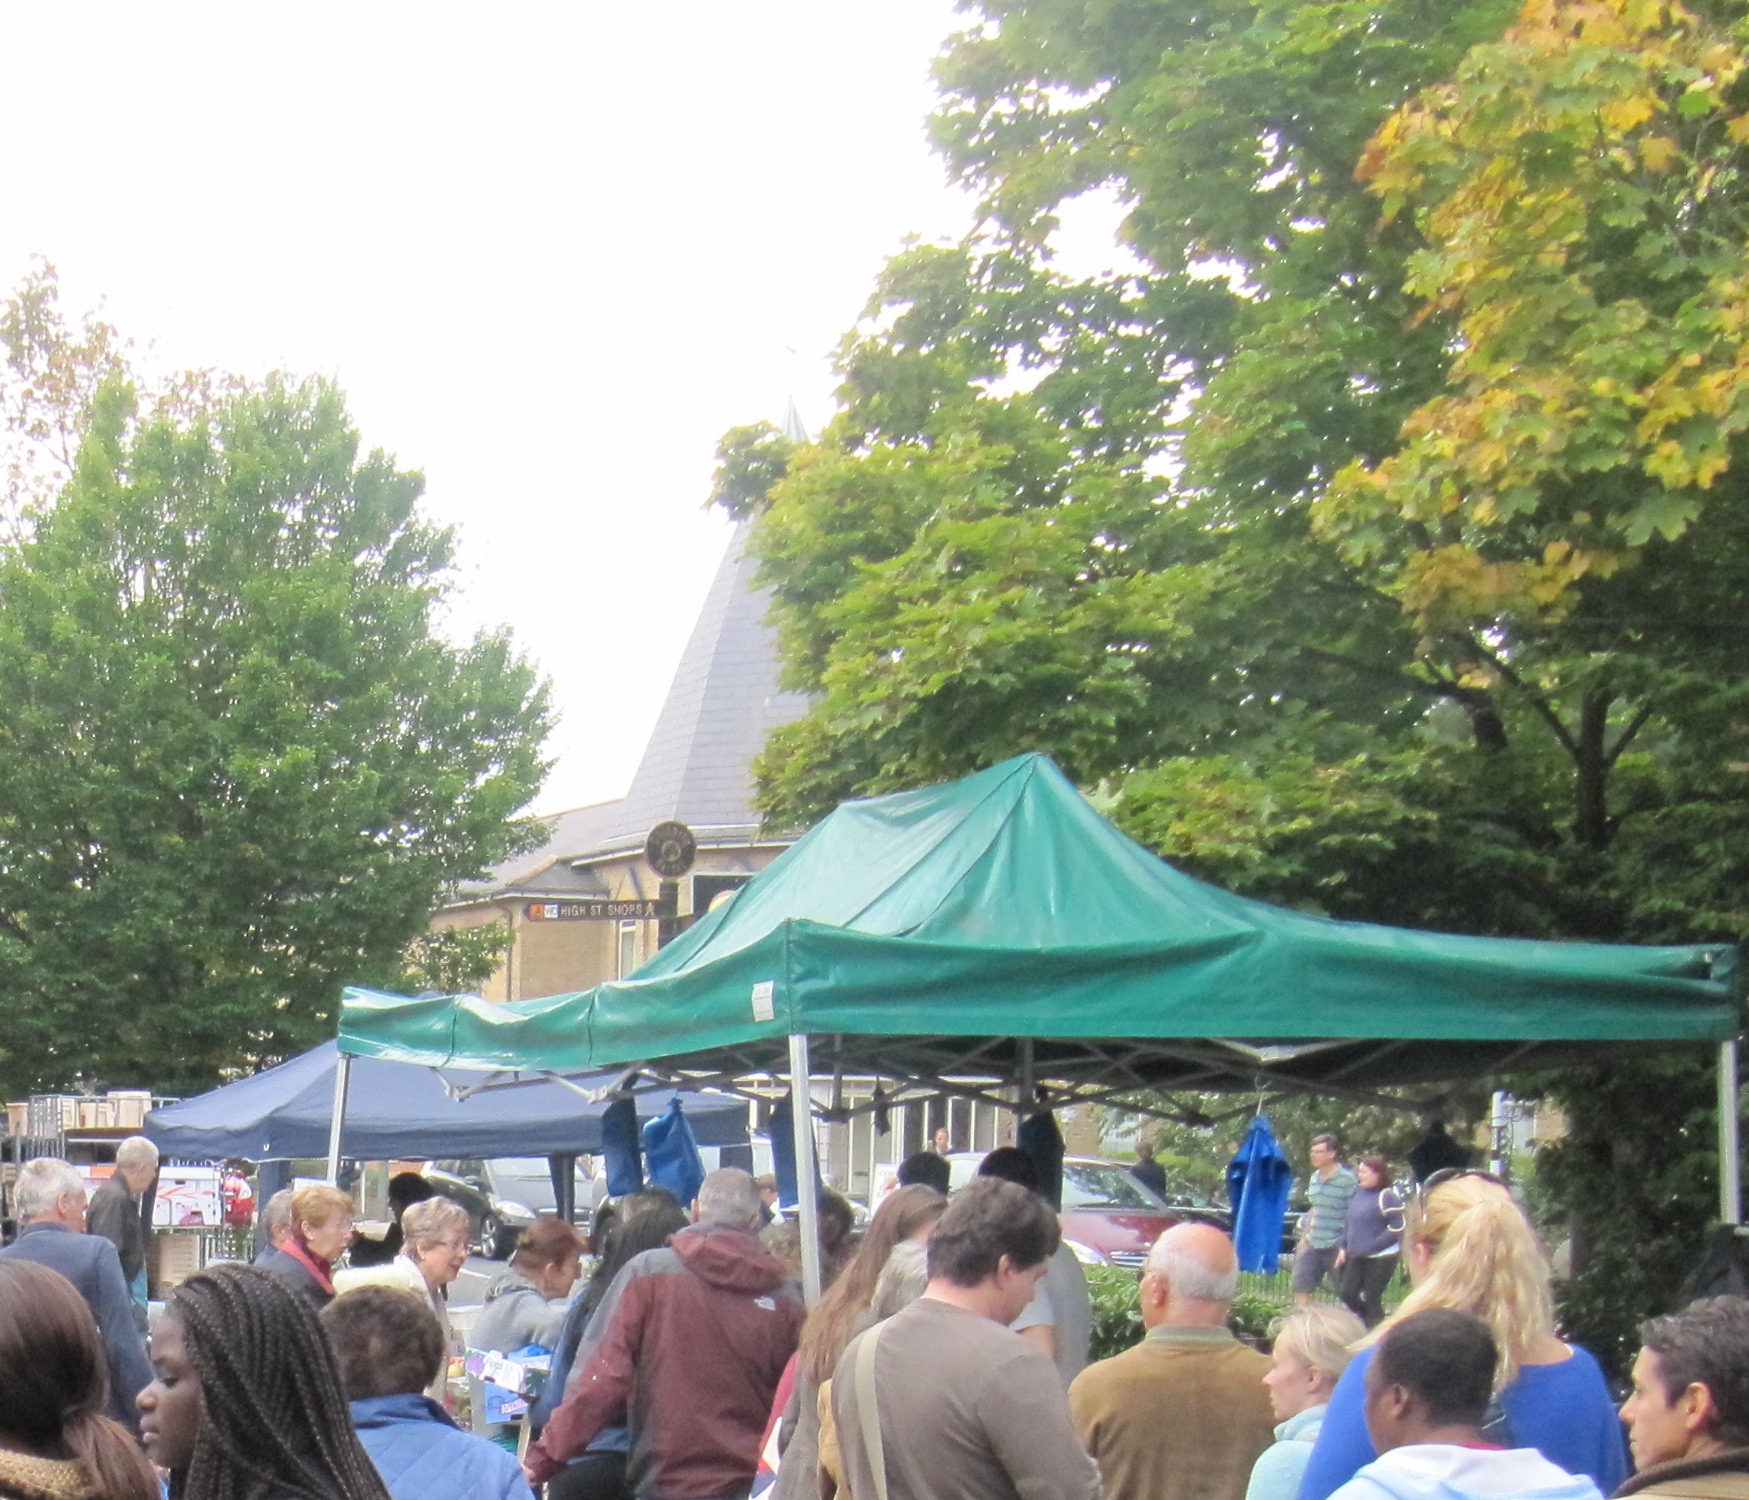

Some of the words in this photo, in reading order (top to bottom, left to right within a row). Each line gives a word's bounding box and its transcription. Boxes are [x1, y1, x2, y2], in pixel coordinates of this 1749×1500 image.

[561, 904, 586, 916] HIGH
[590, 904, 602, 916] ST
[607, 903, 642, 916] SHOPS
